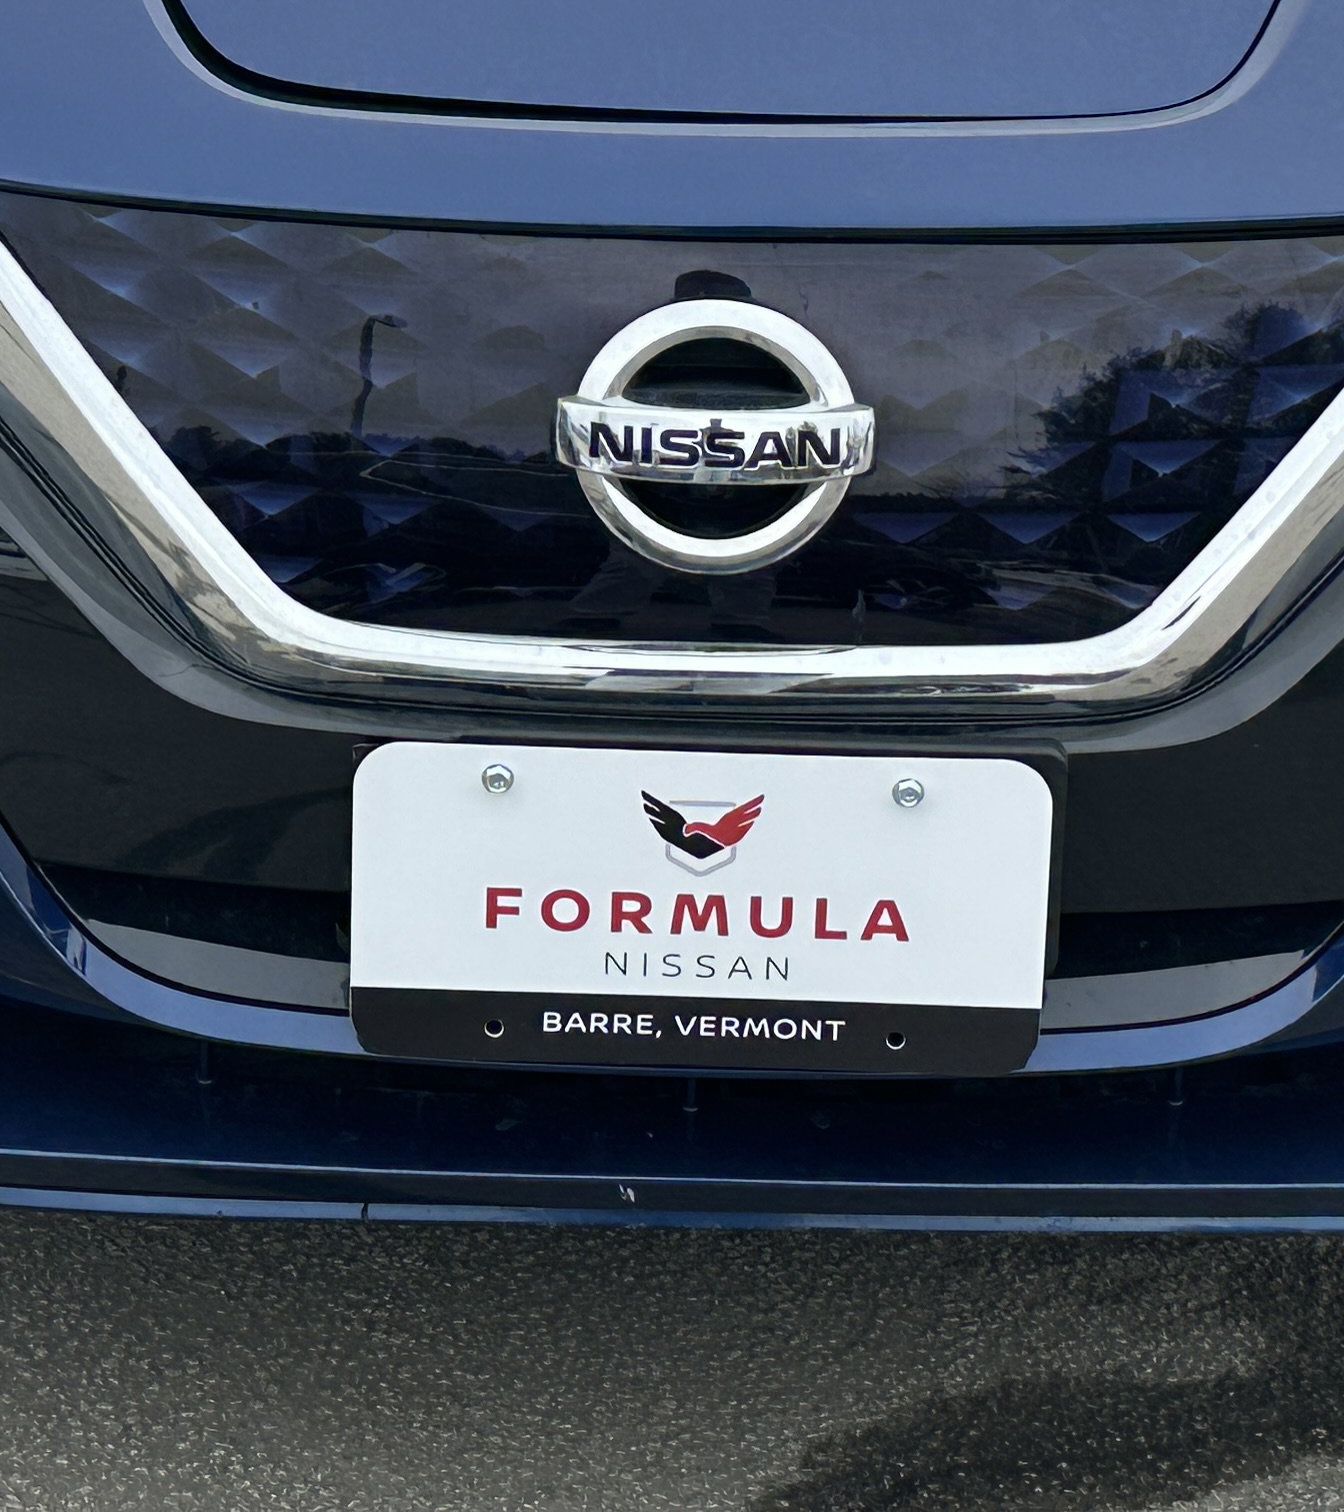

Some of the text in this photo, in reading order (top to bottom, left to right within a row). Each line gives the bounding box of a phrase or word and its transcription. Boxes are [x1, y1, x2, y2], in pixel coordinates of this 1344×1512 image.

[588, 420, 842, 469] NISSAN
[485, 886, 911, 943] FORMULA
[604, 950, 791, 982] NISSAN
[542, 1010, 847, 1043] BARRE, VERMONT
